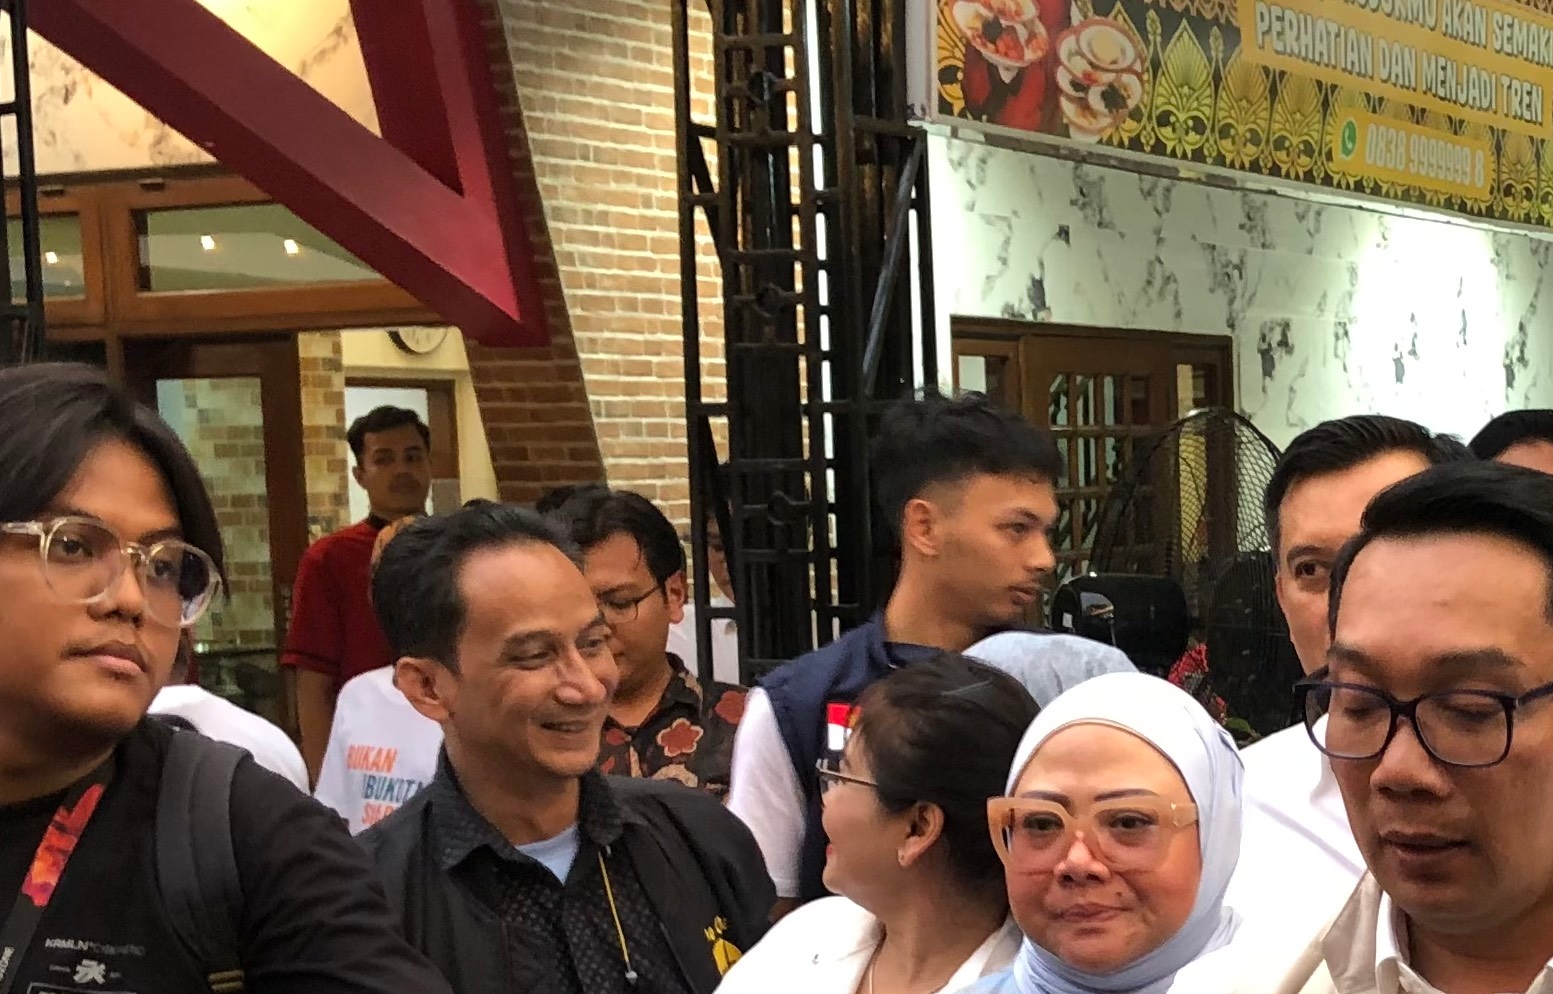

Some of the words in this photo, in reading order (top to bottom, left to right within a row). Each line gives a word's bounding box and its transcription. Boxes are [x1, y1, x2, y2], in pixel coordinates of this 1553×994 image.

[1255, 1, 1374, 81] PERHATIAN
[1378, 37, 1417, 92] DAN
[1421, 51, 1497, 113] MENJADI
[1500, 74, 1544, 125] TREN
[1442, 0, 1488, 49] AKAN
